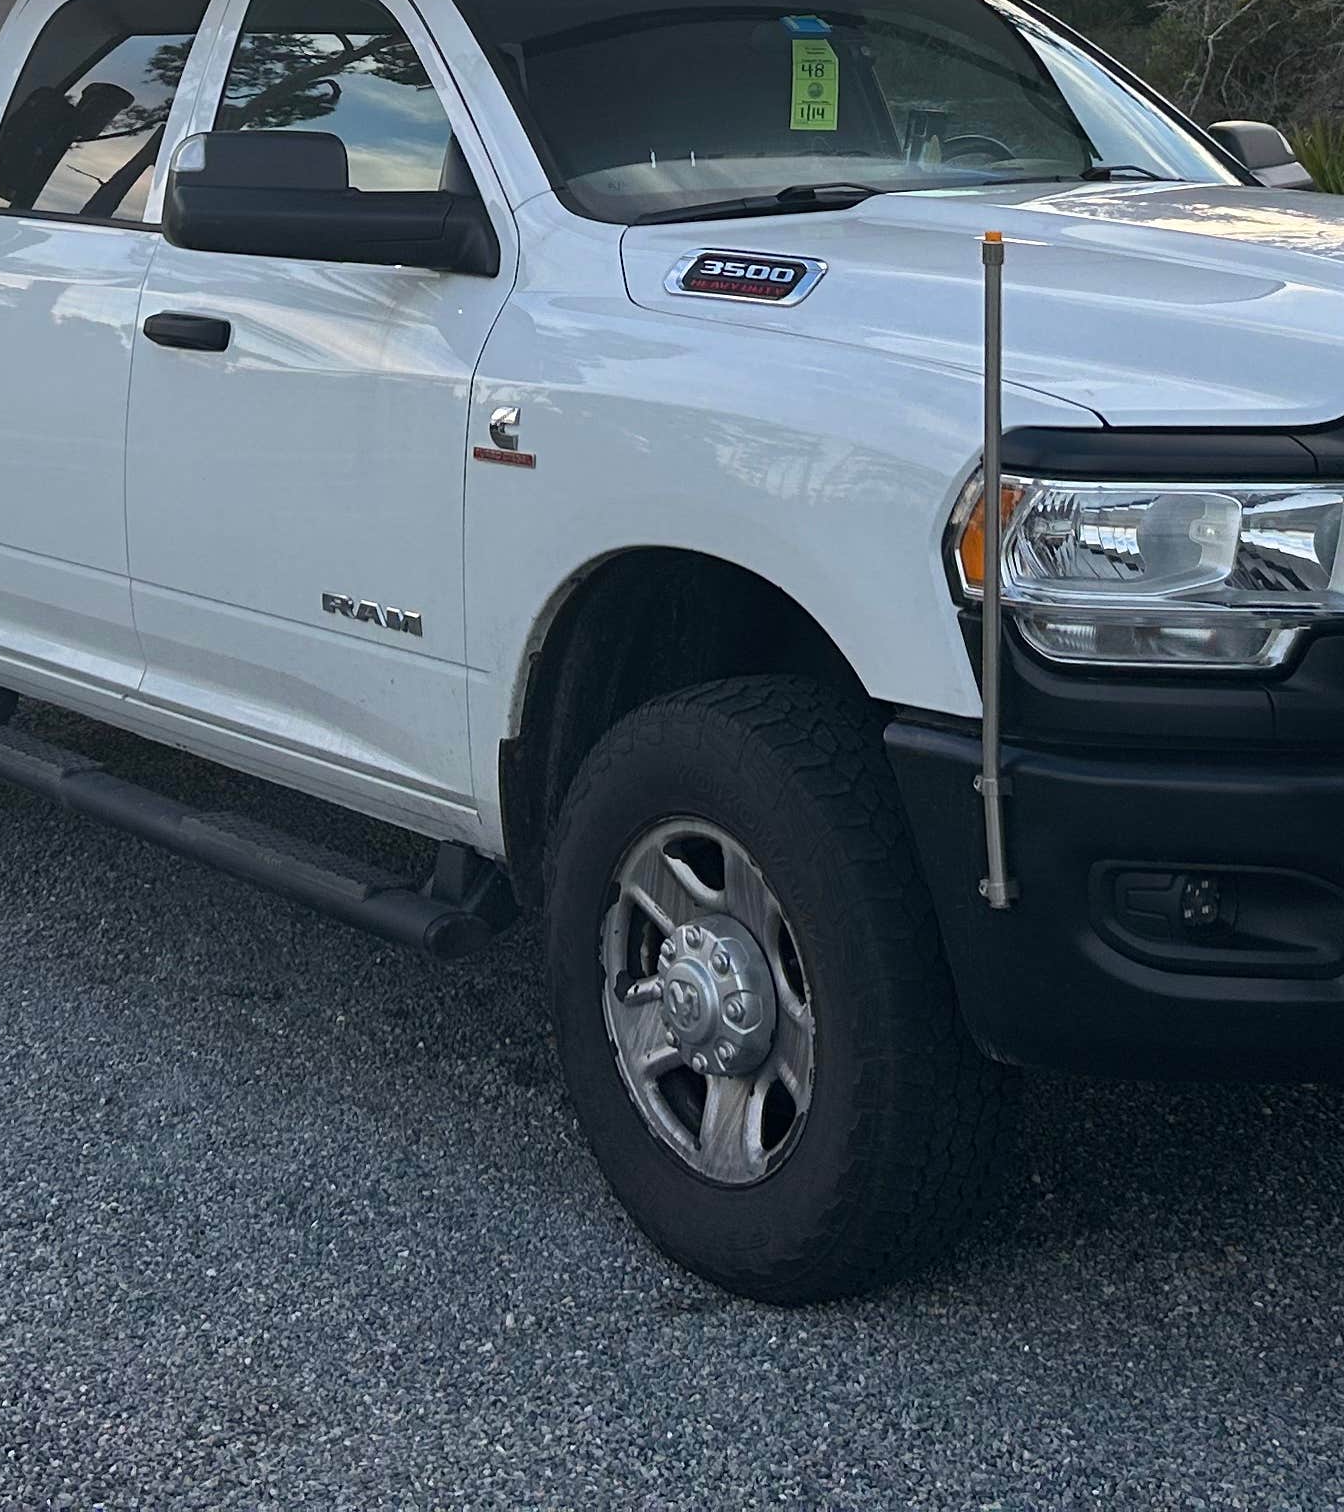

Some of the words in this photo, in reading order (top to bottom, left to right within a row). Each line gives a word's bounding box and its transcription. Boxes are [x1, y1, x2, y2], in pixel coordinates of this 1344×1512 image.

[801, 63, 825, 78] 48
[800, 103, 825, 122] 1/14
[699, 260, 796, 283] 3500
[321, 592, 424, 638] RAM
